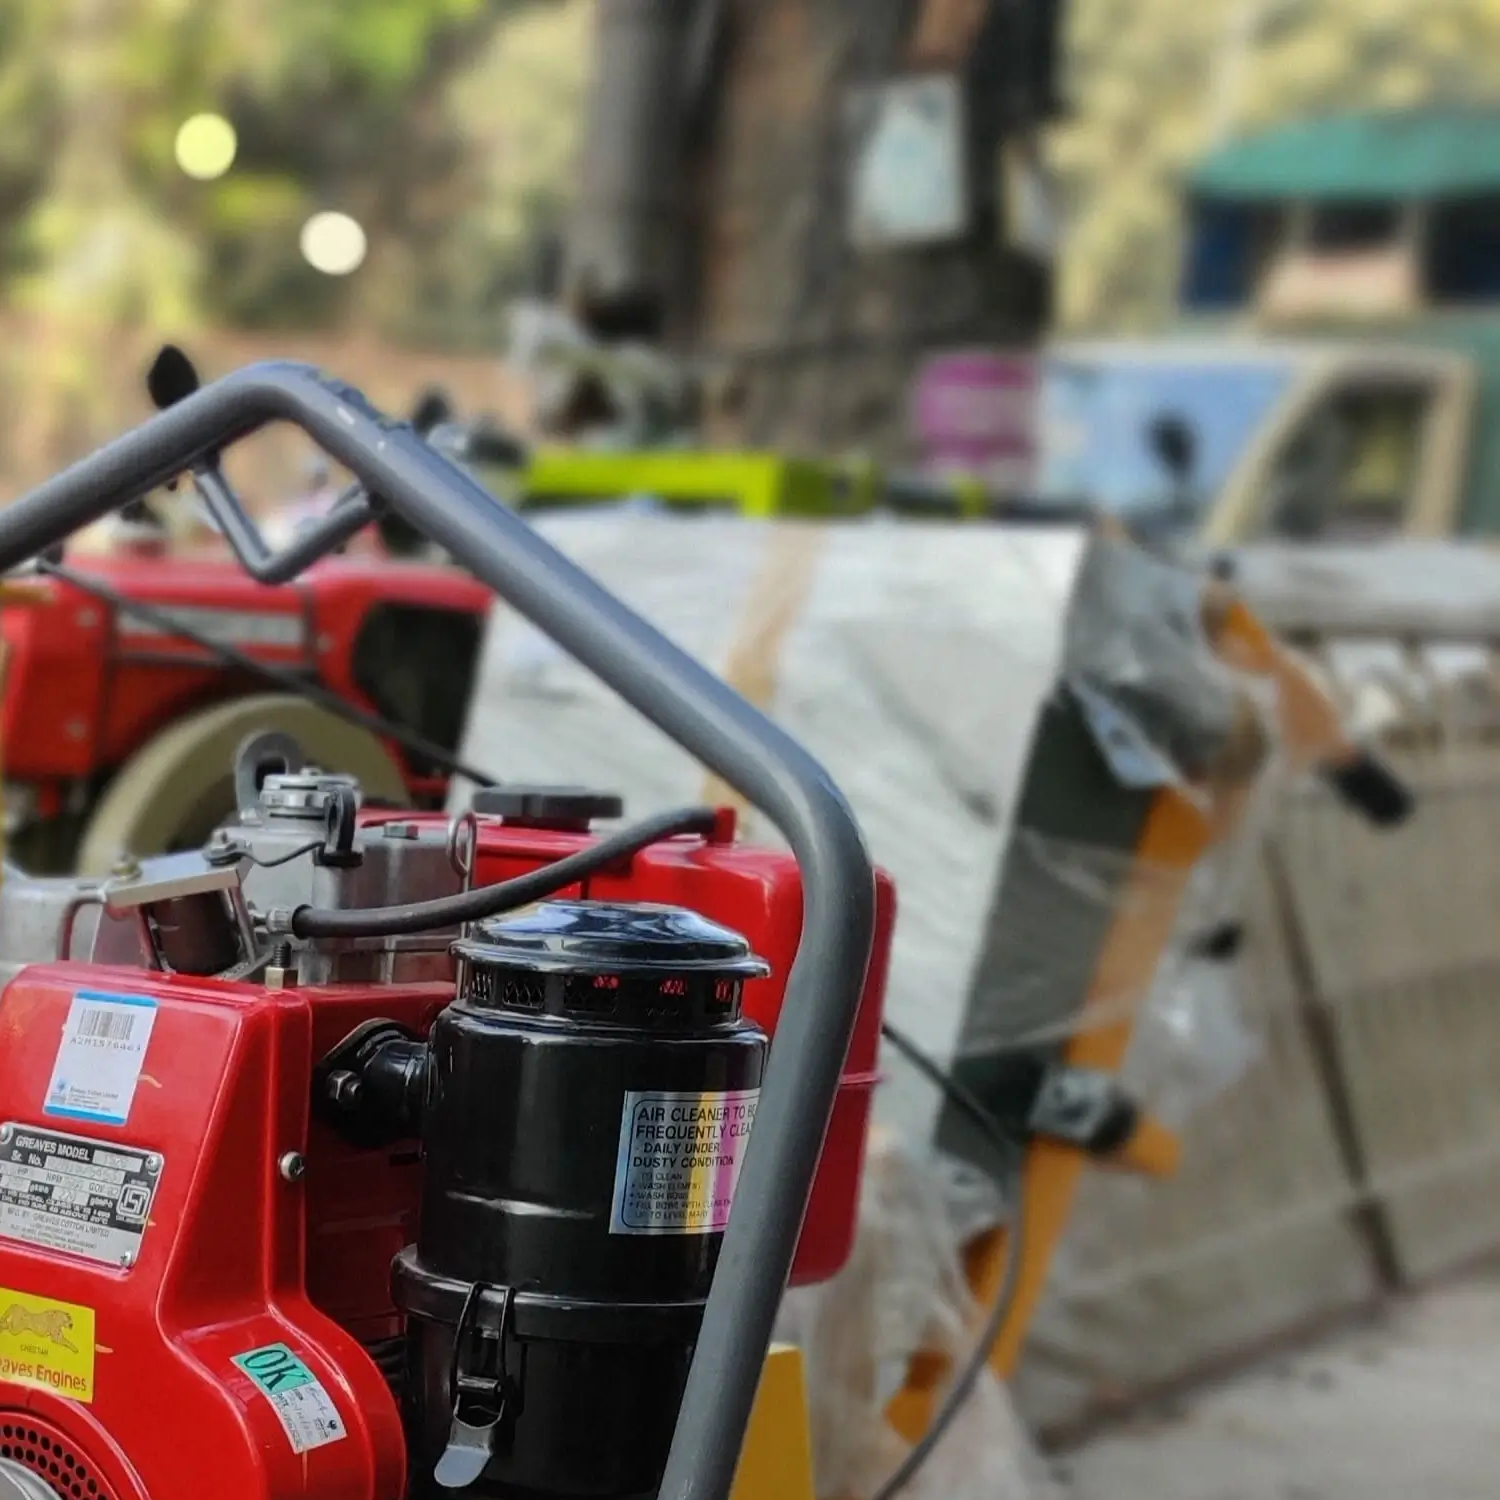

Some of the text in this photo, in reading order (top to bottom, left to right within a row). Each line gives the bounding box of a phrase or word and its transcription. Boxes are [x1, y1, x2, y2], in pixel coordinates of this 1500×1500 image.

[637, 1107, 665, 1122] AIR
[670, 1107, 730, 1122] CLEANER
[734, 1106, 745, 1120] TO
[636, 1123, 726, 1140] FREQUENTLY
[15, 1135, 58, 1155] GREAVES
[57, 1143, 90, 1161] MODEL
[643, 1142, 720, 1154] DAILY UNDER
[633, 1156, 734, 1169] DUSTY CONDITION
[36, 1364, 87, 1392] Engines
[244, 1350, 308, 1392] OK
